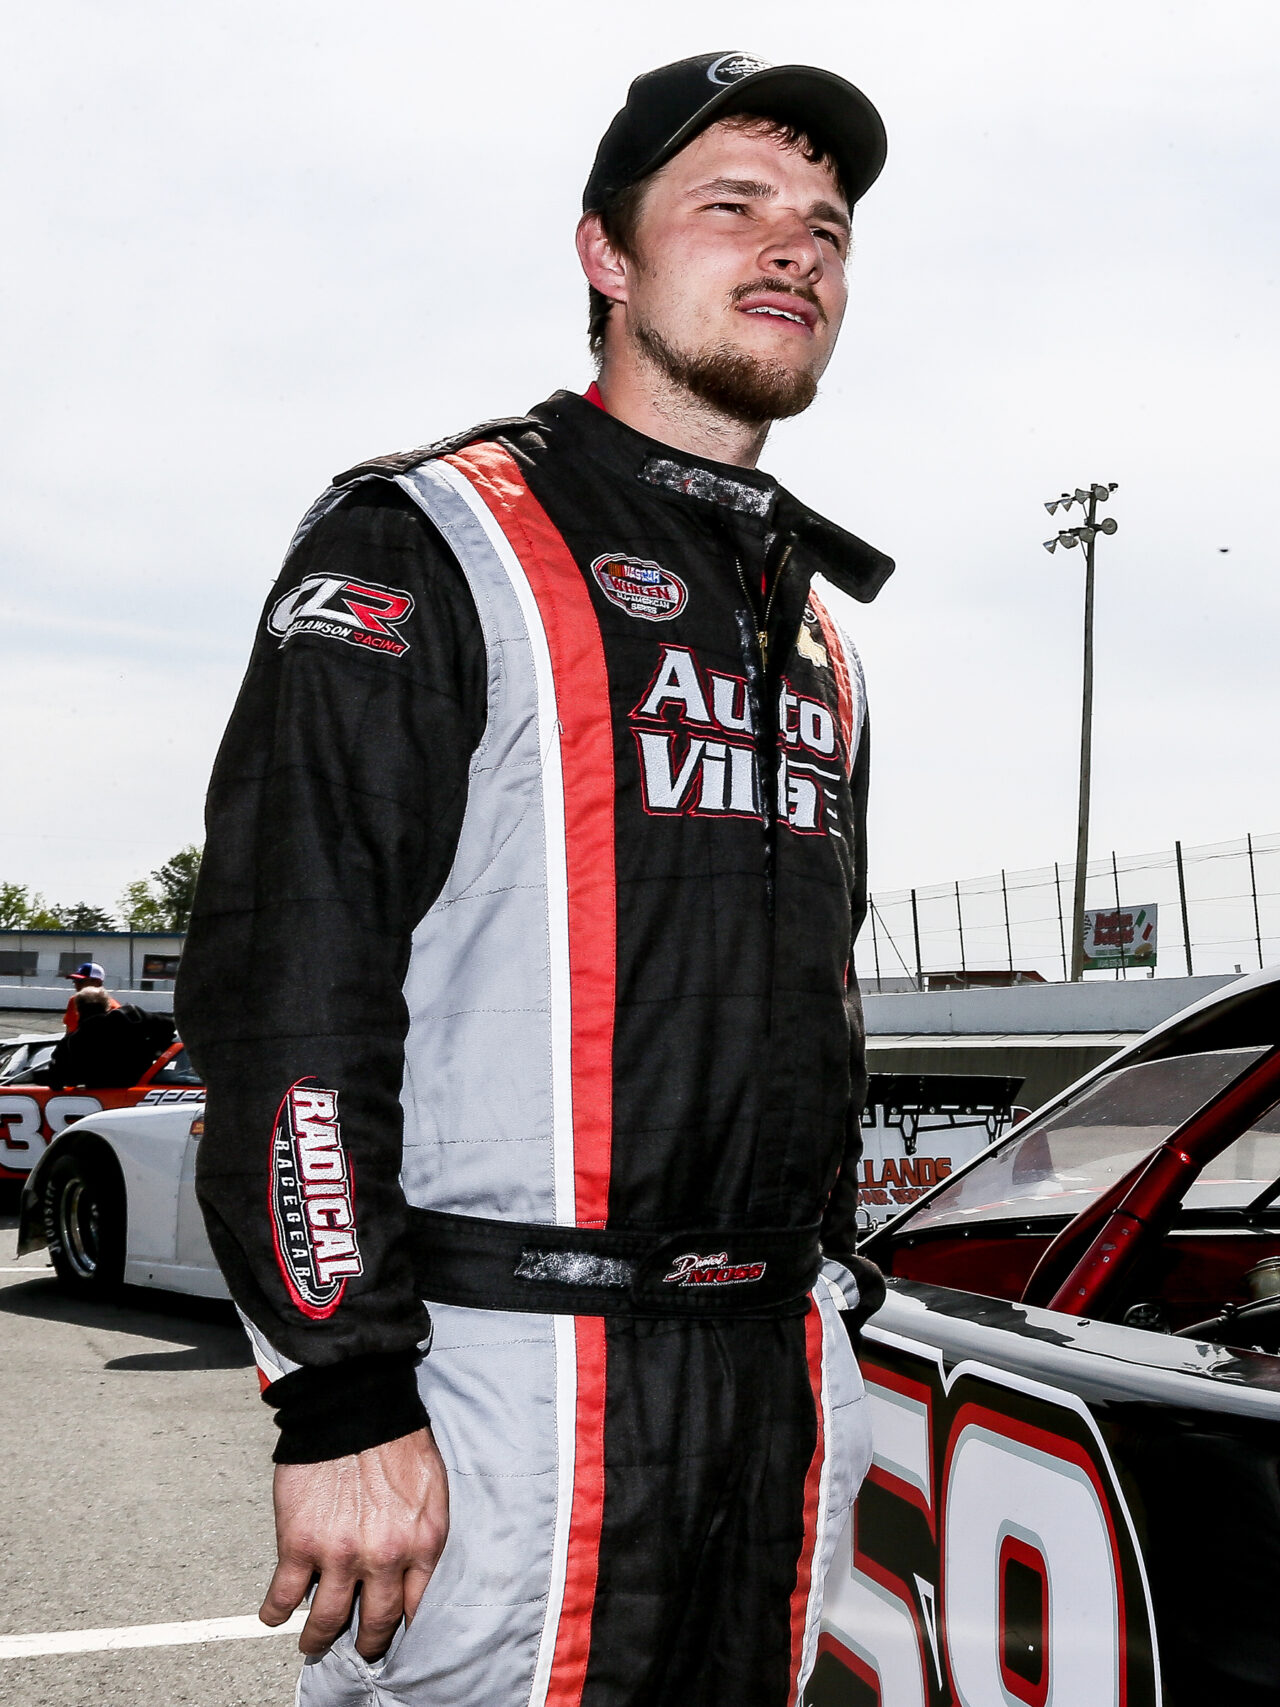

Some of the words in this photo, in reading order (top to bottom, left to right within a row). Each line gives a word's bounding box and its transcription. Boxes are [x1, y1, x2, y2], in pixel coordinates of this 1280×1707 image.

[352, 631, 405, 655] RACING
[293, 1088, 362, 1285] RADICAL
[857, 1158, 952, 1189] LANDS
[687, 1264, 764, 1283] MOSS
